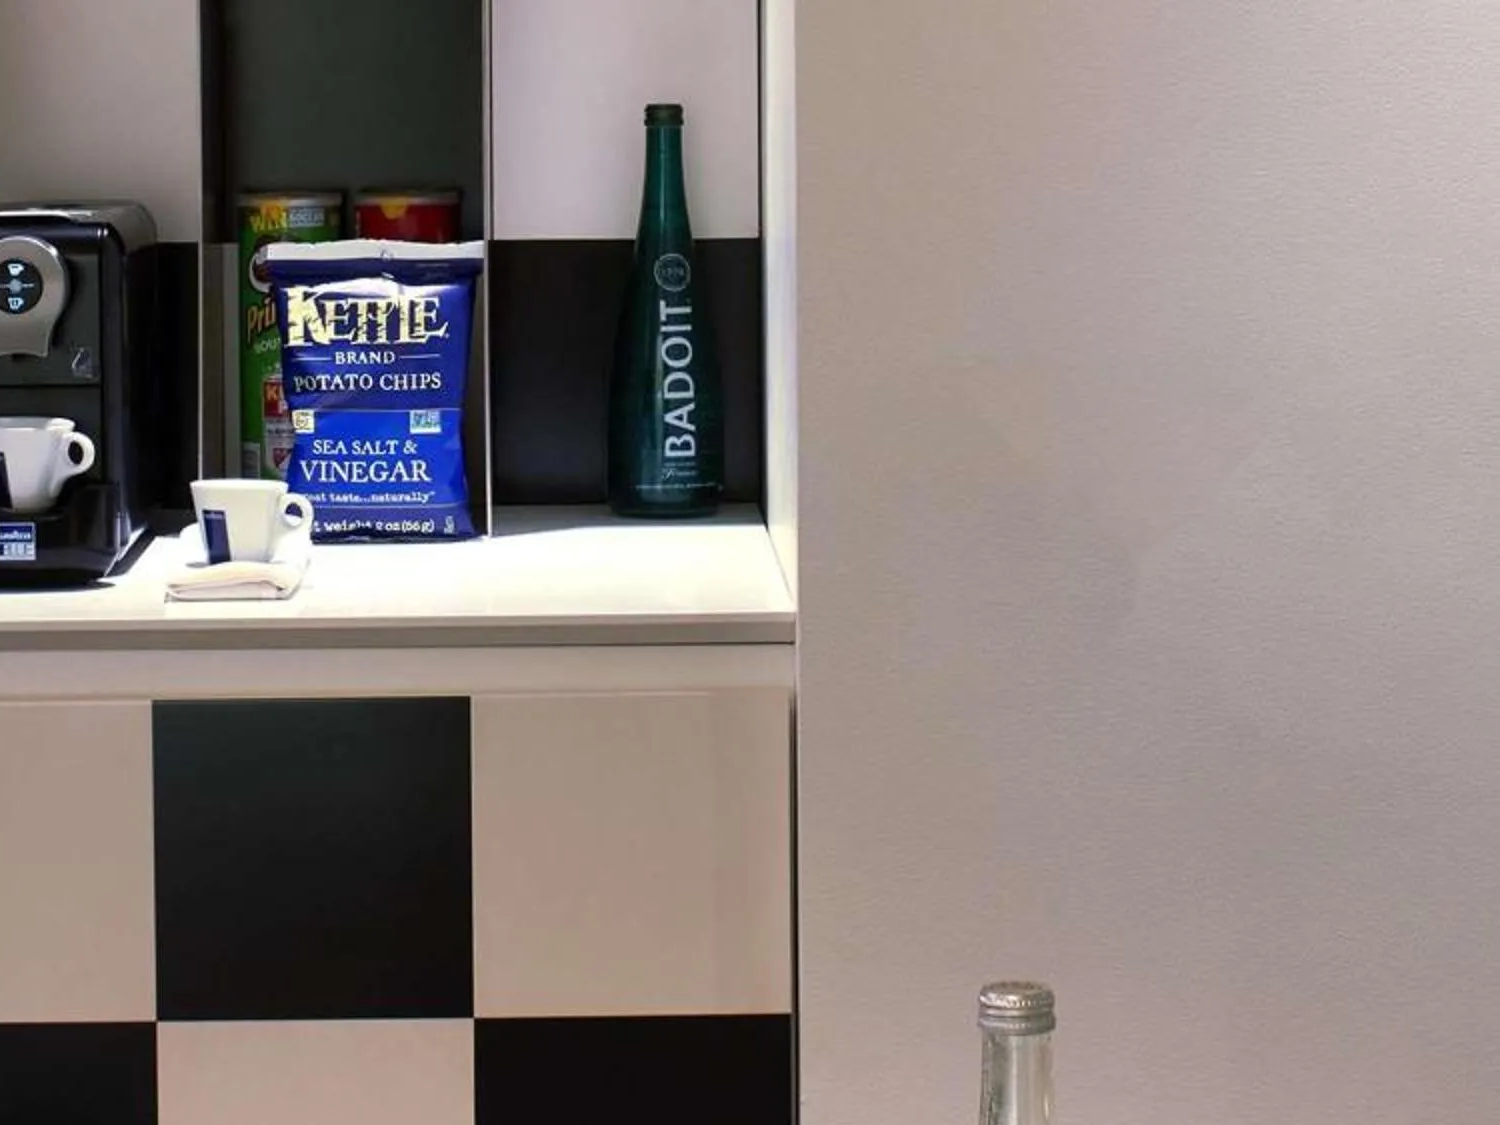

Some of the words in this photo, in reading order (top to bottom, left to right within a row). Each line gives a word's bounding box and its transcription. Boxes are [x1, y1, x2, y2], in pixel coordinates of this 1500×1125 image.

[284, 286, 448, 346] KETTLE
[334, 351, 396, 365] BRAND
[294, 373, 373, 391] POTATO
[379, 372, 442, 391] CHIPS
[660, 300, 696, 458] BADOIT
[312, 439, 348, 455] SEA
[351, 439, 399, 455] SALT
[403, 439, 418, 455] &
[300, 459, 432, 483] VINEGAR
